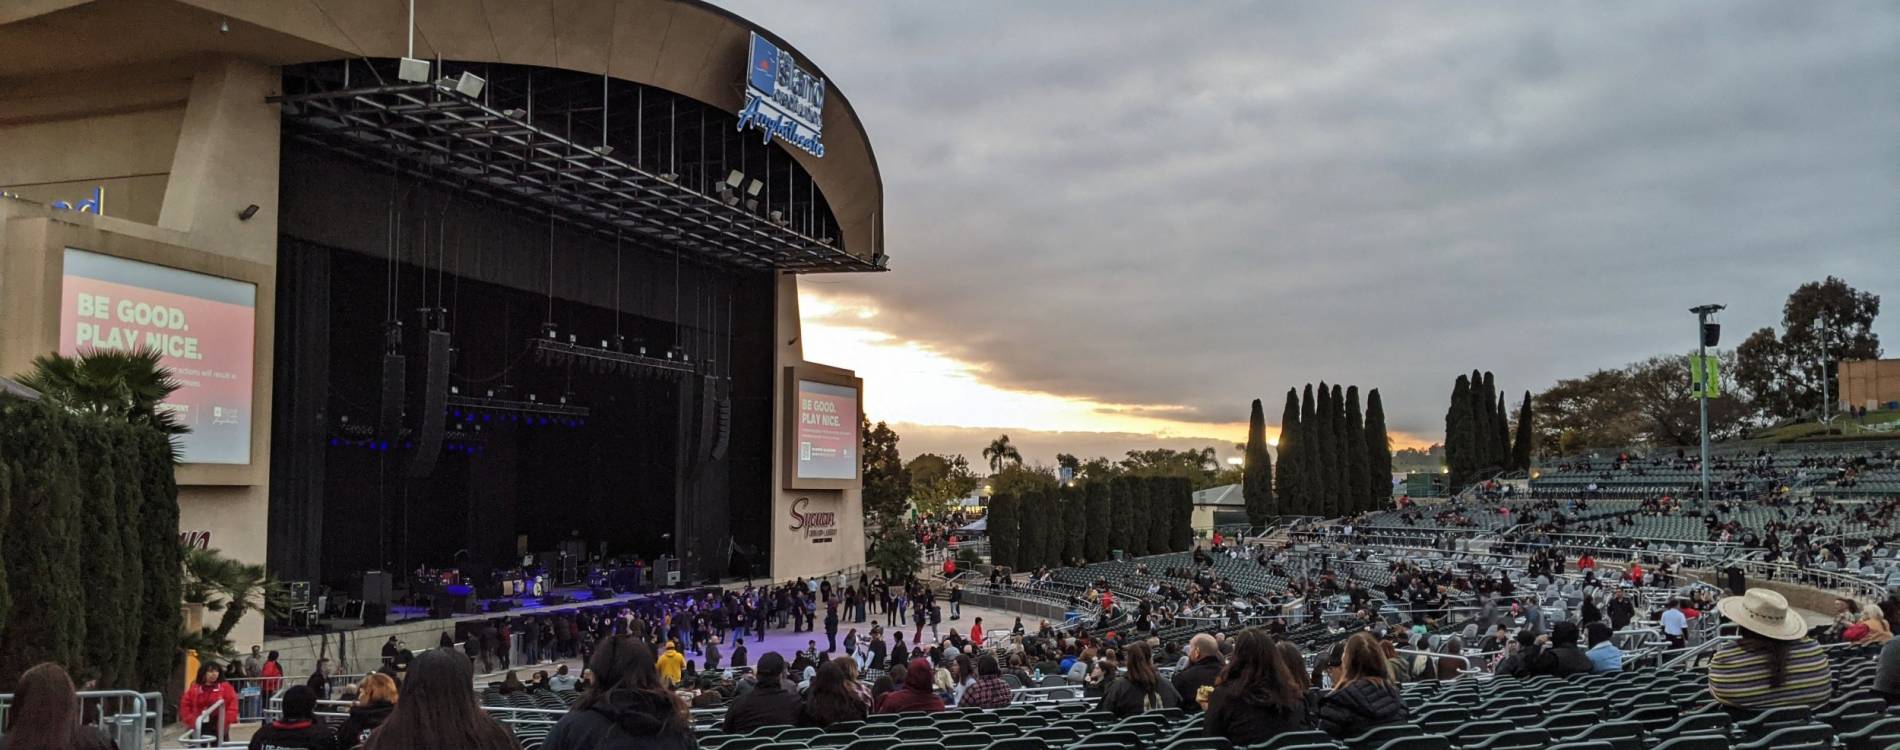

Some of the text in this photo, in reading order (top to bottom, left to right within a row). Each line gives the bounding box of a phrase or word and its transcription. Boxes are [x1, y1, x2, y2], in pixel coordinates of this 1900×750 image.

[78, 292, 189, 331] BE GOOD.
[76, 322, 202, 360] PLAY NICE.
[802, 399, 837, 413] BE GOOD.
[802, 412, 840, 427] PLAY NICE.
